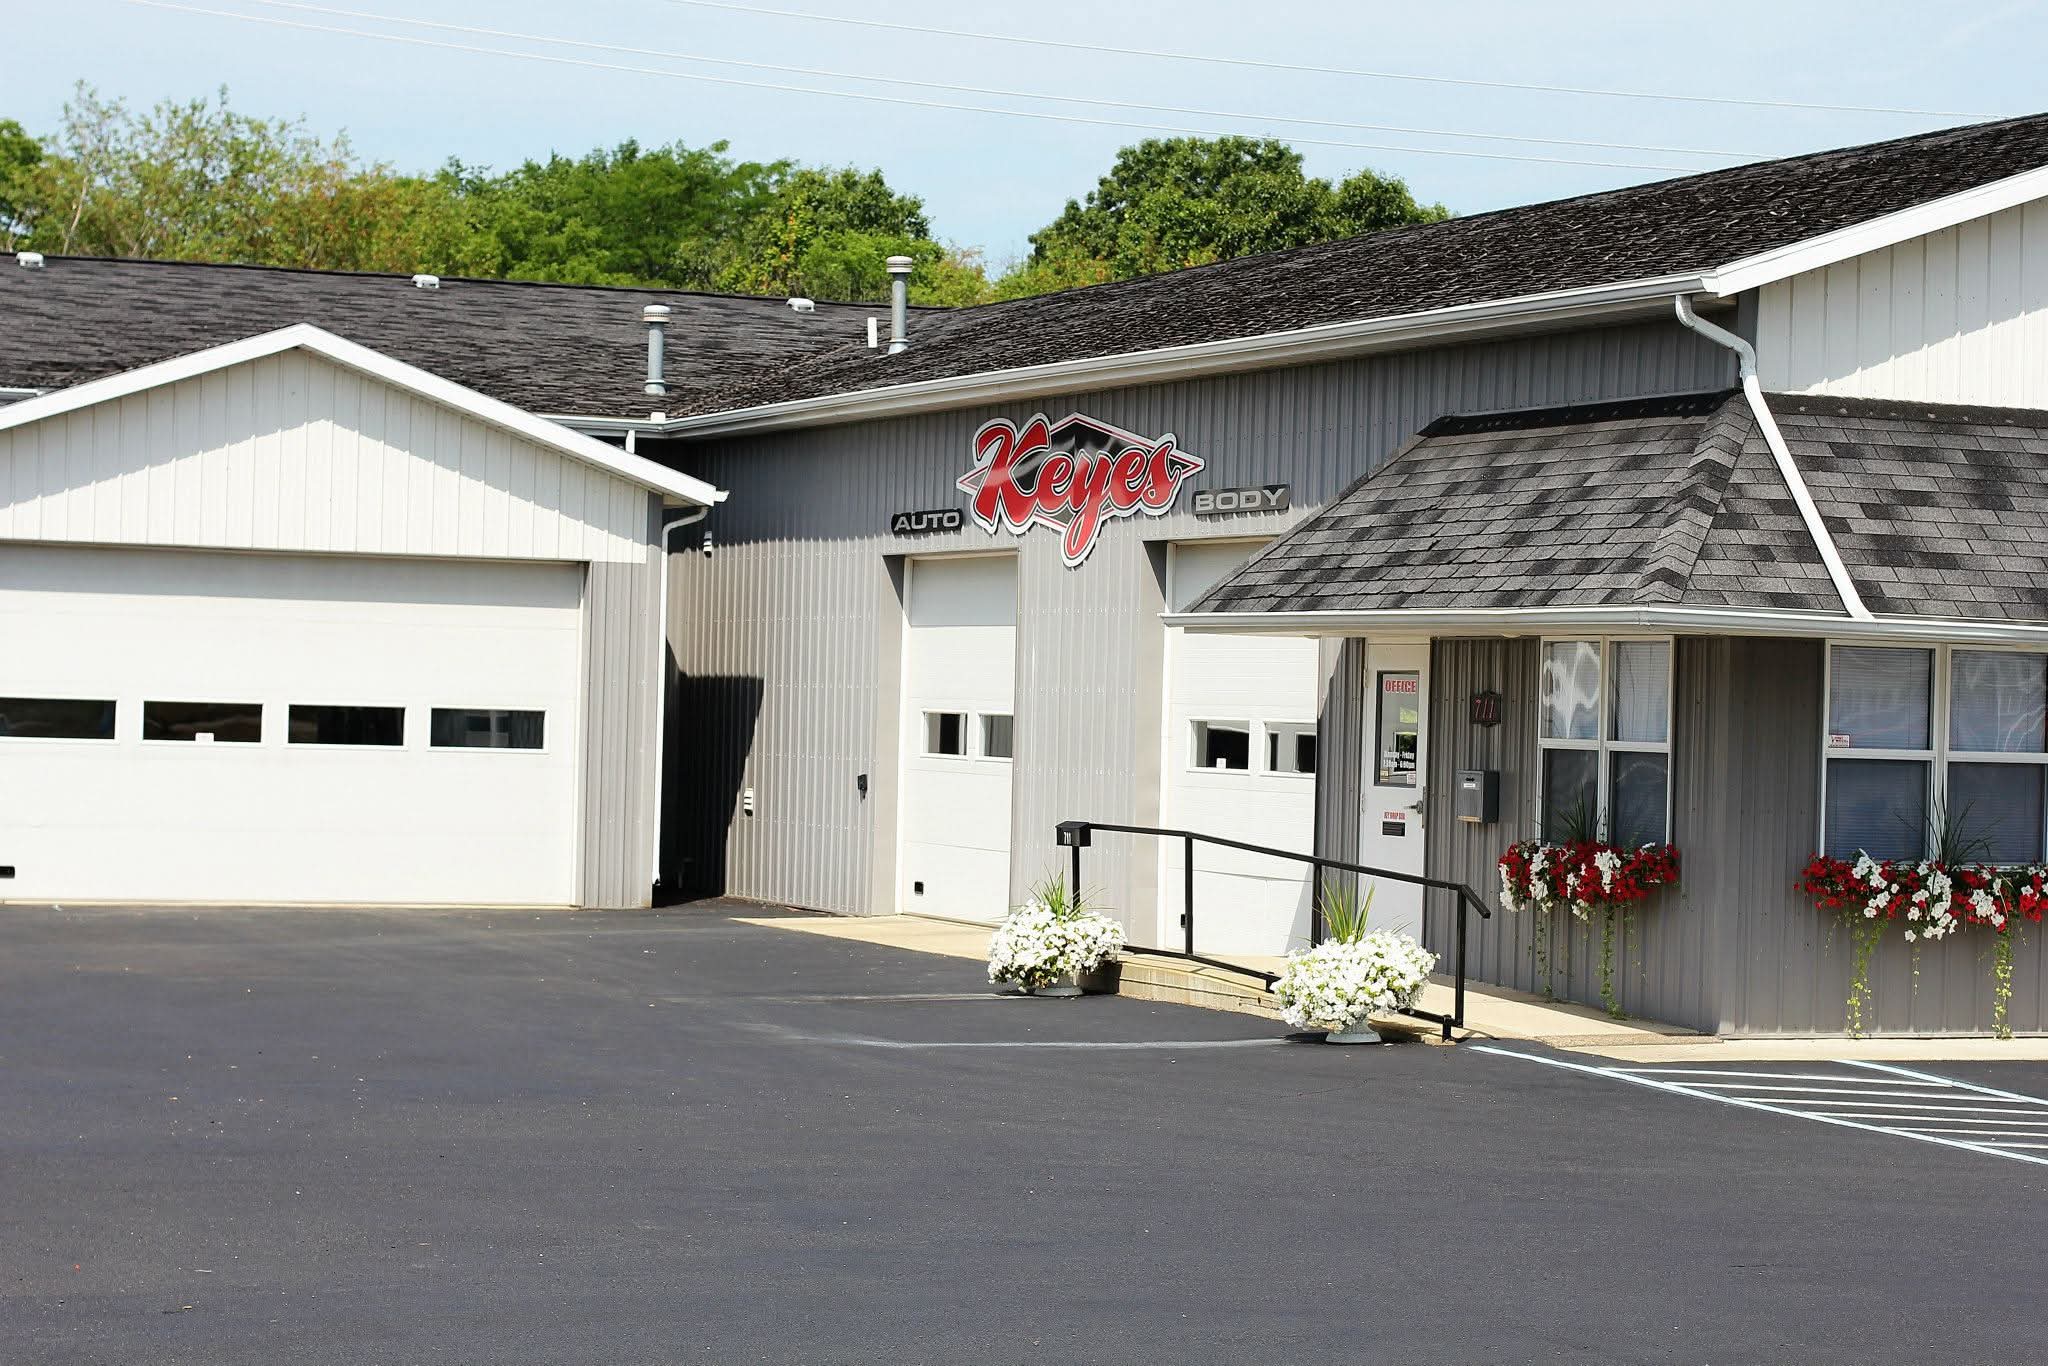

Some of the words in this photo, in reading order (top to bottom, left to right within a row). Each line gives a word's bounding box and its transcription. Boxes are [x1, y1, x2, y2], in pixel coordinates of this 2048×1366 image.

[974, 418, 1182, 560] Keyes
[1195, 488, 1286, 511] BODY
[893, 511, 960, 531] AUTO
[1385, 680, 1416, 692] OFFICE
